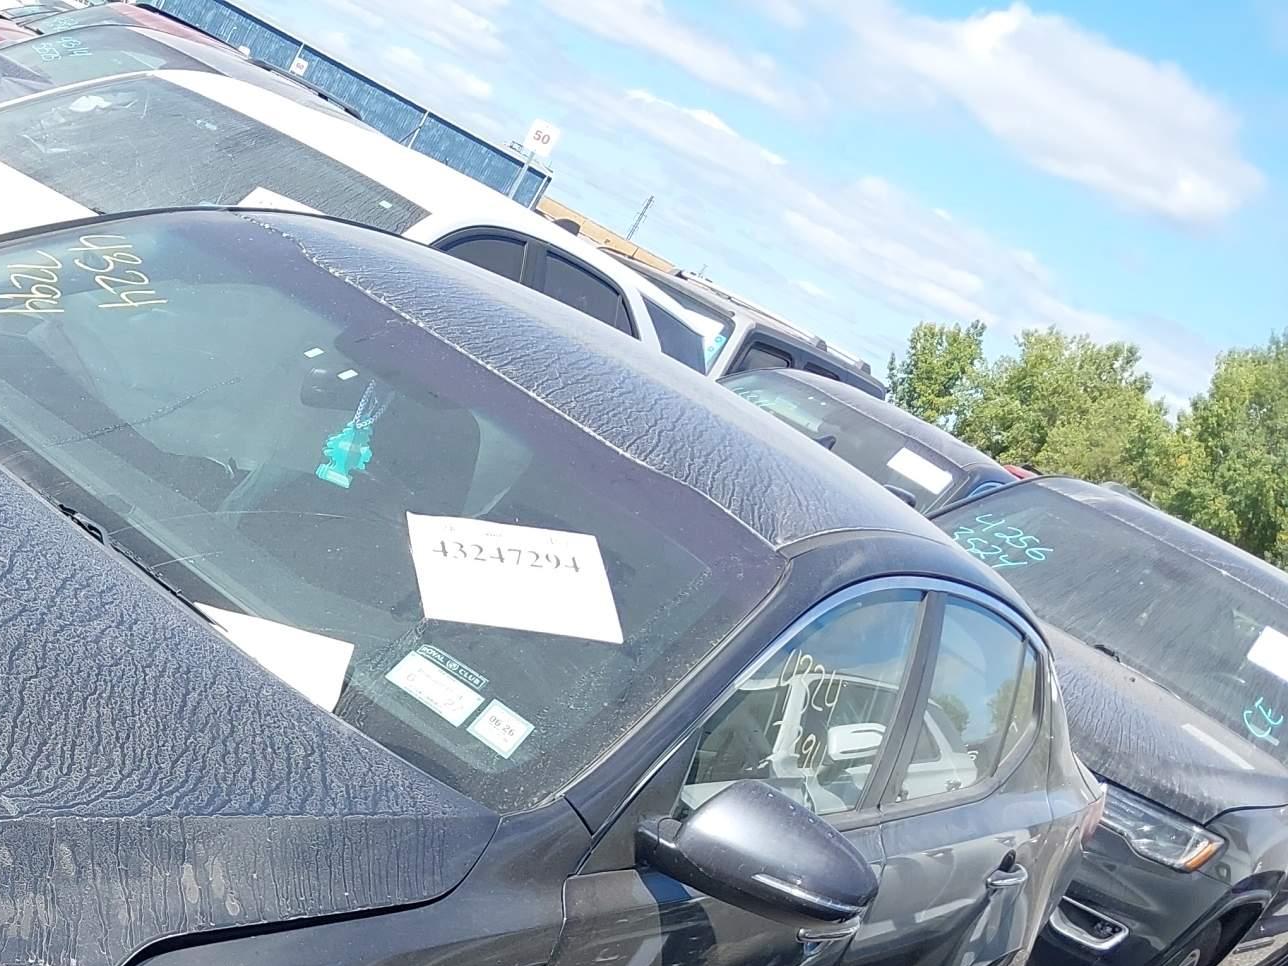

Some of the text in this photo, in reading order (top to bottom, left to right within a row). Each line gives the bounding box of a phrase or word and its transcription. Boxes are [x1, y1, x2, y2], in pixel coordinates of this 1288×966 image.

[533, 130, 550, 145] 50
[68, 234, 168, 308] 4324
[432, 540, 580, 573] 43247294
[976, 513, 1054, 561] 4256
[422, 646, 481, 686] ROYAL CLUB
[780, 648, 843, 727] 4324
